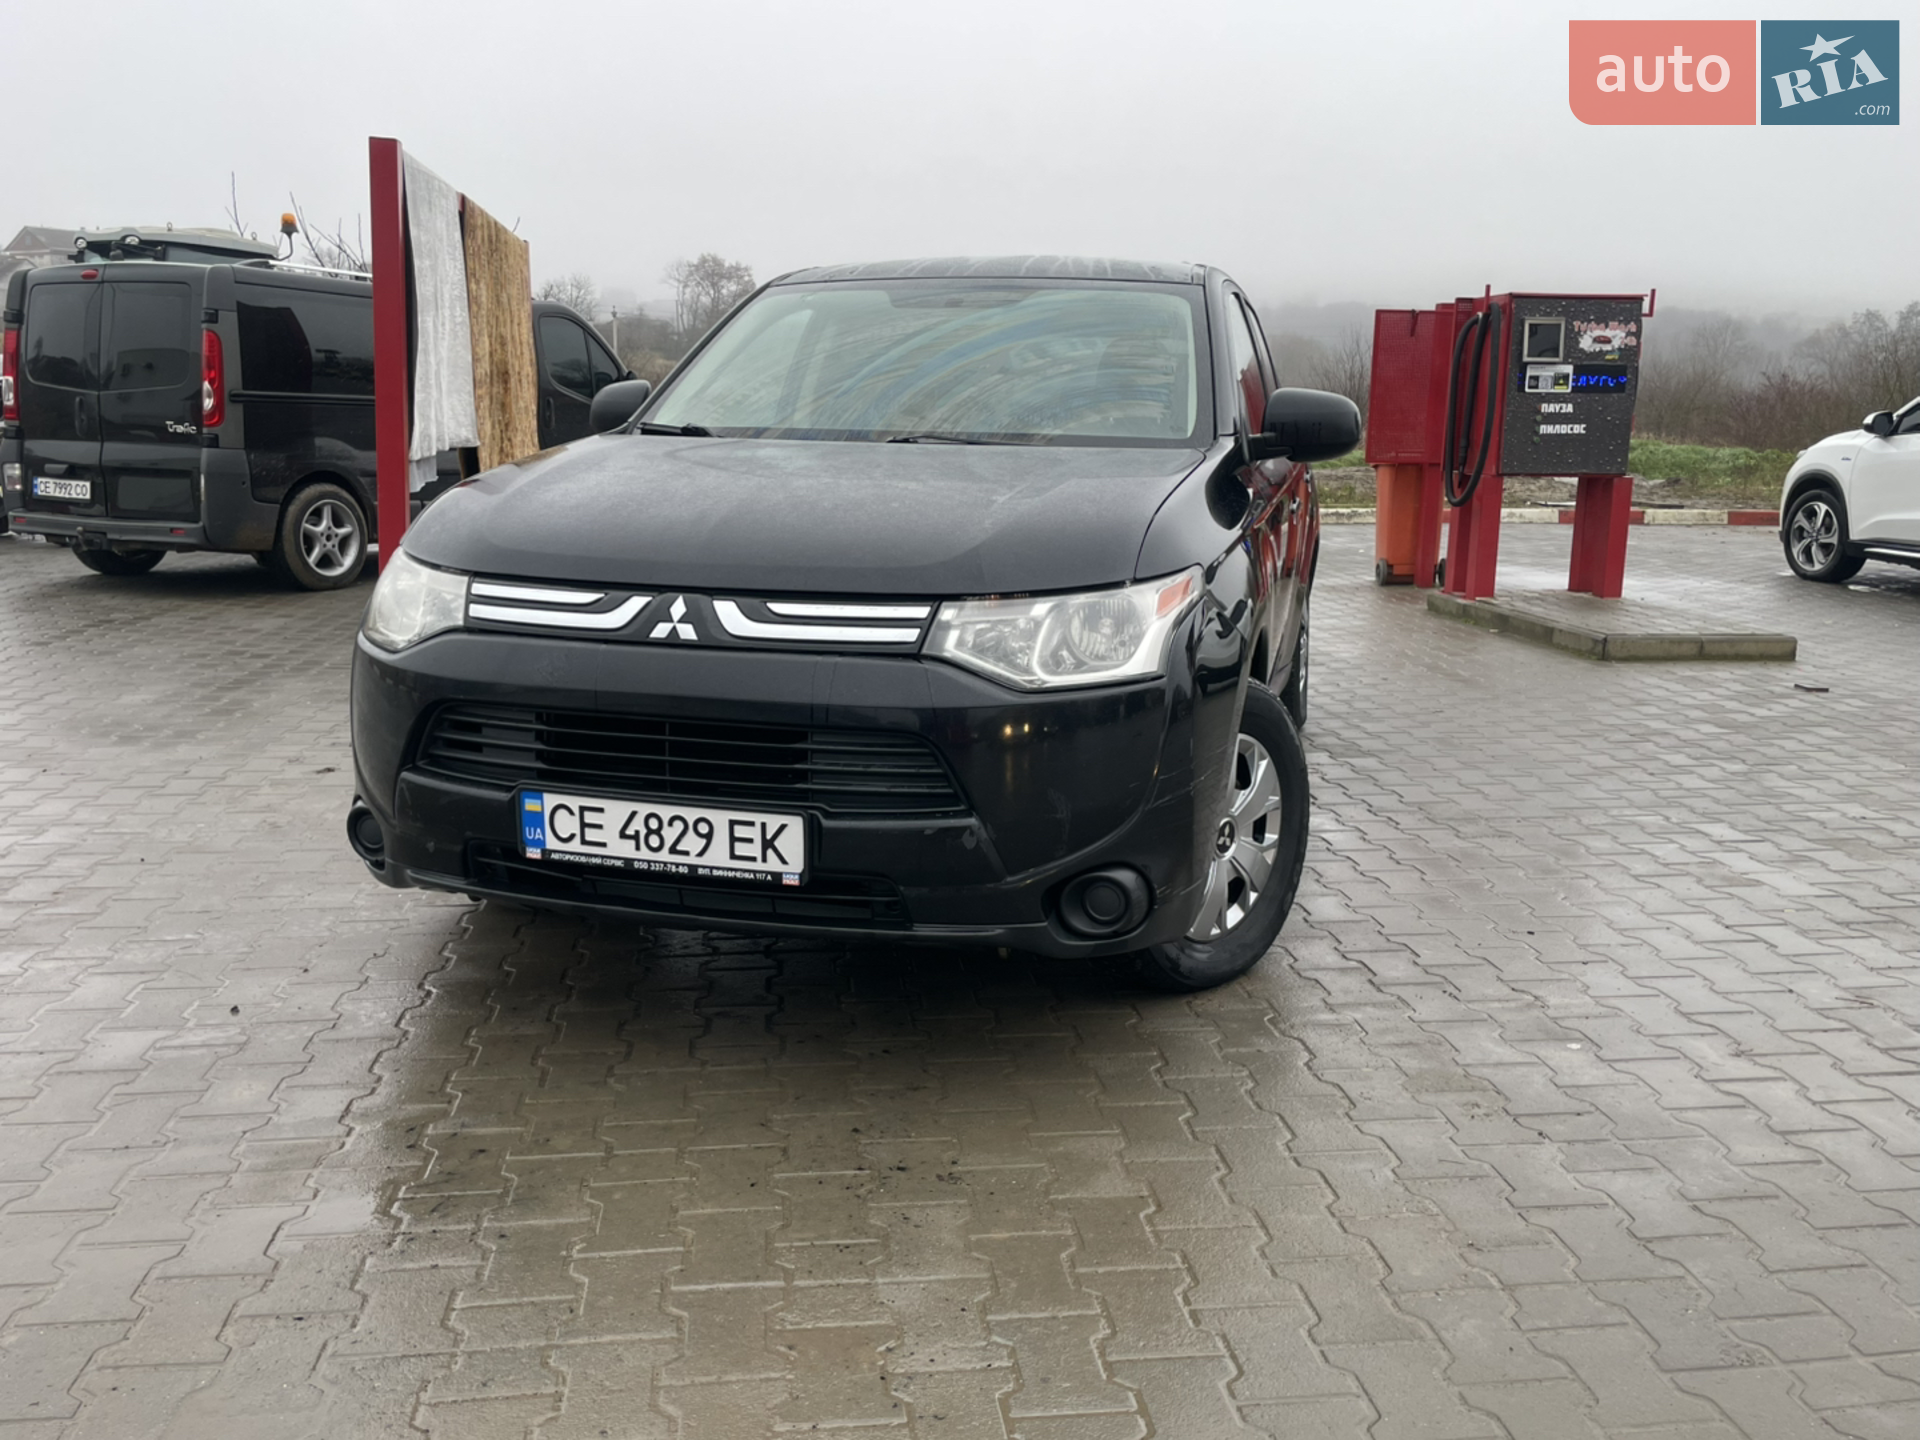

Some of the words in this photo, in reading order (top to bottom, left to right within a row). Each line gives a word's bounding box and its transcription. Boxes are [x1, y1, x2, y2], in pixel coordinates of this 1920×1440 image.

[1541, 402, 1574, 414] ПАУЗА
[165, 420, 198, 435] Trafic
[1539, 423, 1587, 435] ПИЛОСОС
[40, 480, 51, 494] CE
[52, 481, 73, 496] 7992
[74, 483, 89, 497] CO
[525, 827, 544, 841] UA
[549, 803, 607, 848] CE
[618, 810, 714, 858] 4829
[728, 818, 789, 865] EK
[633, 860, 649, 869] 050
